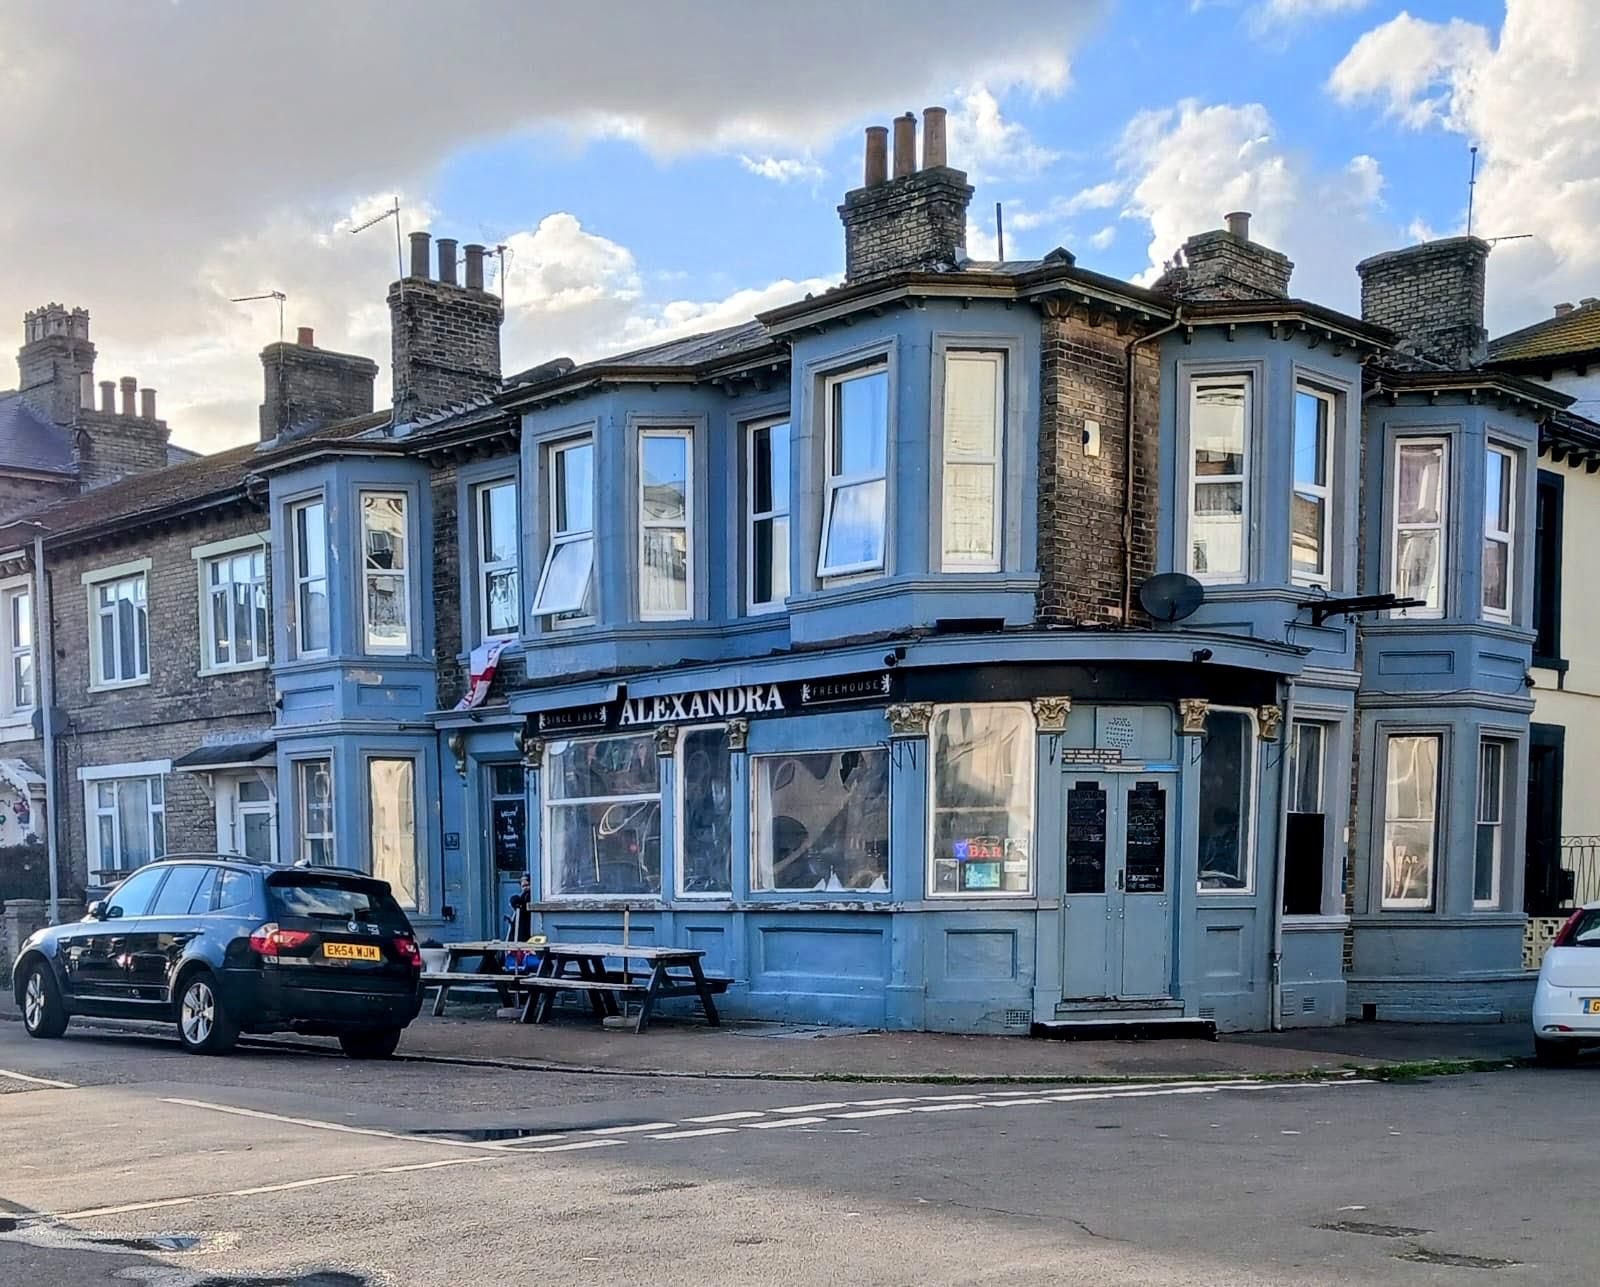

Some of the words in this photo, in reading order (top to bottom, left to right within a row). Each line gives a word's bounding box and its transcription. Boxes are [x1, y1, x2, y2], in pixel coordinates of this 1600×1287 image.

[812, 679, 880, 697] FREEHOUSE
[619, 684, 785, 726] ALEXANDRA
[968, 845, 1002, 858] BAR
